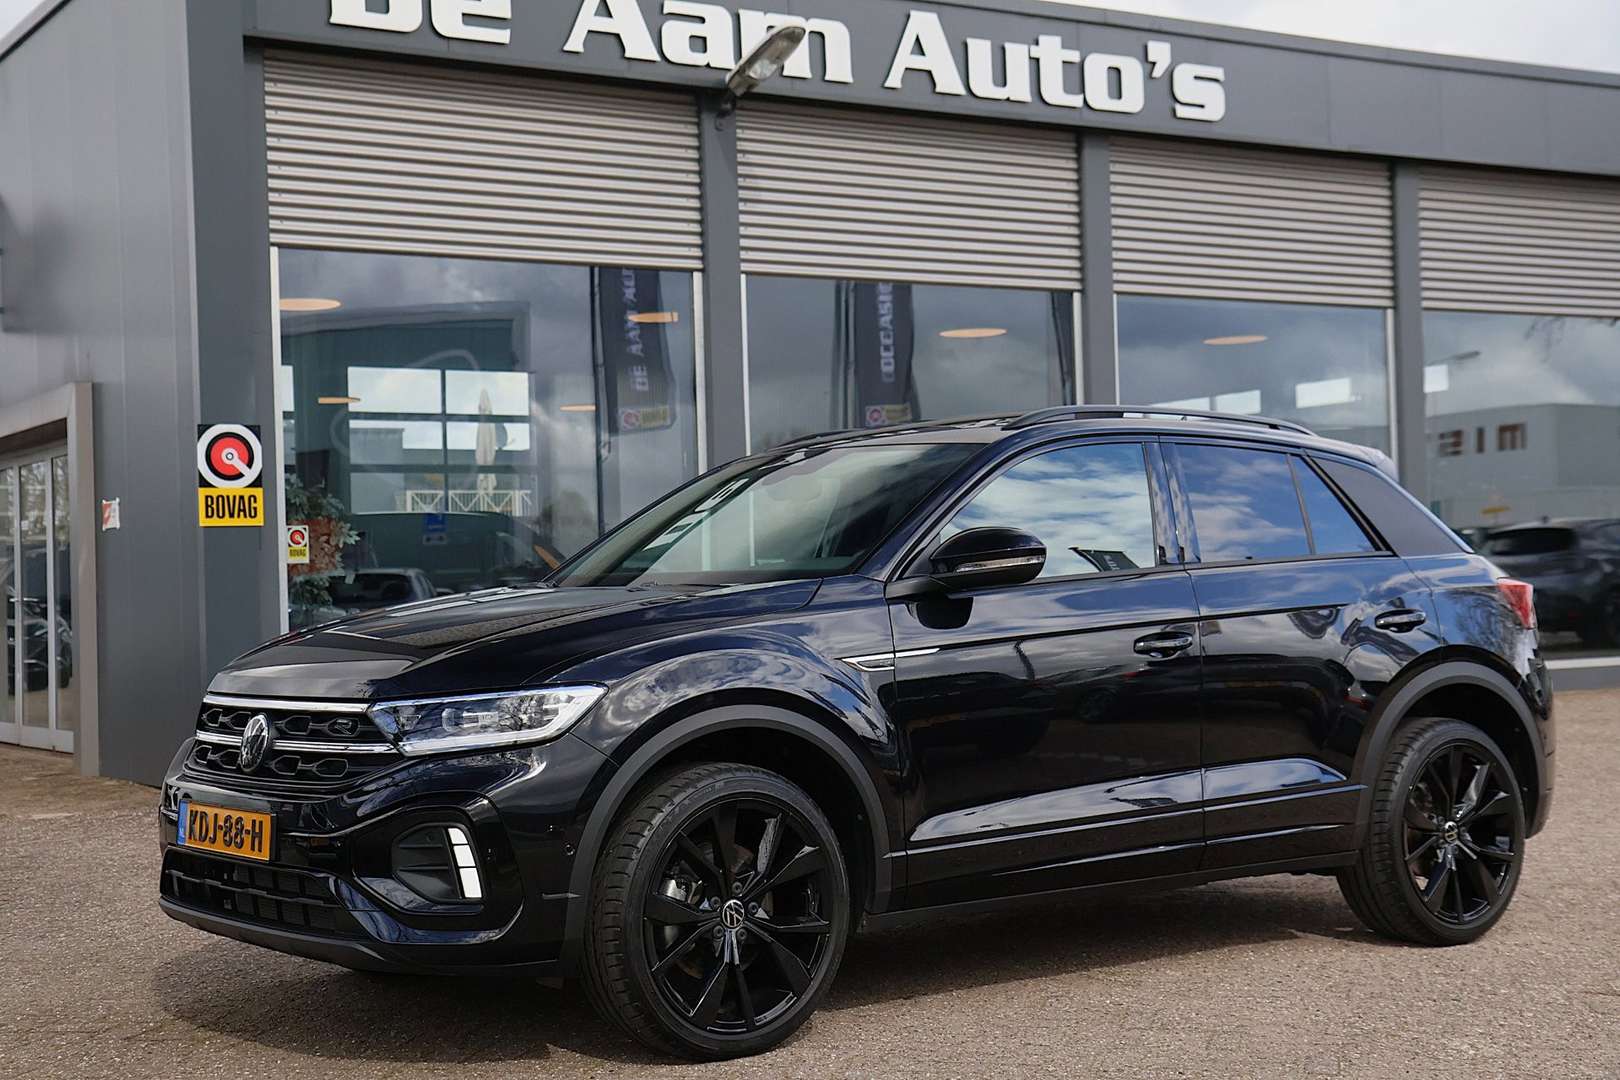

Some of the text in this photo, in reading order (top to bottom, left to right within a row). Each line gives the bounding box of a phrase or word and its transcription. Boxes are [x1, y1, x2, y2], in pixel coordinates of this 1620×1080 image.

[562, 0, 854, 83] Aam
[884, 9, 1226, 122] Auto's
[205, 494, 258, 519] BOVAG
[188, 810, 264, 853] KDJ-88-H
